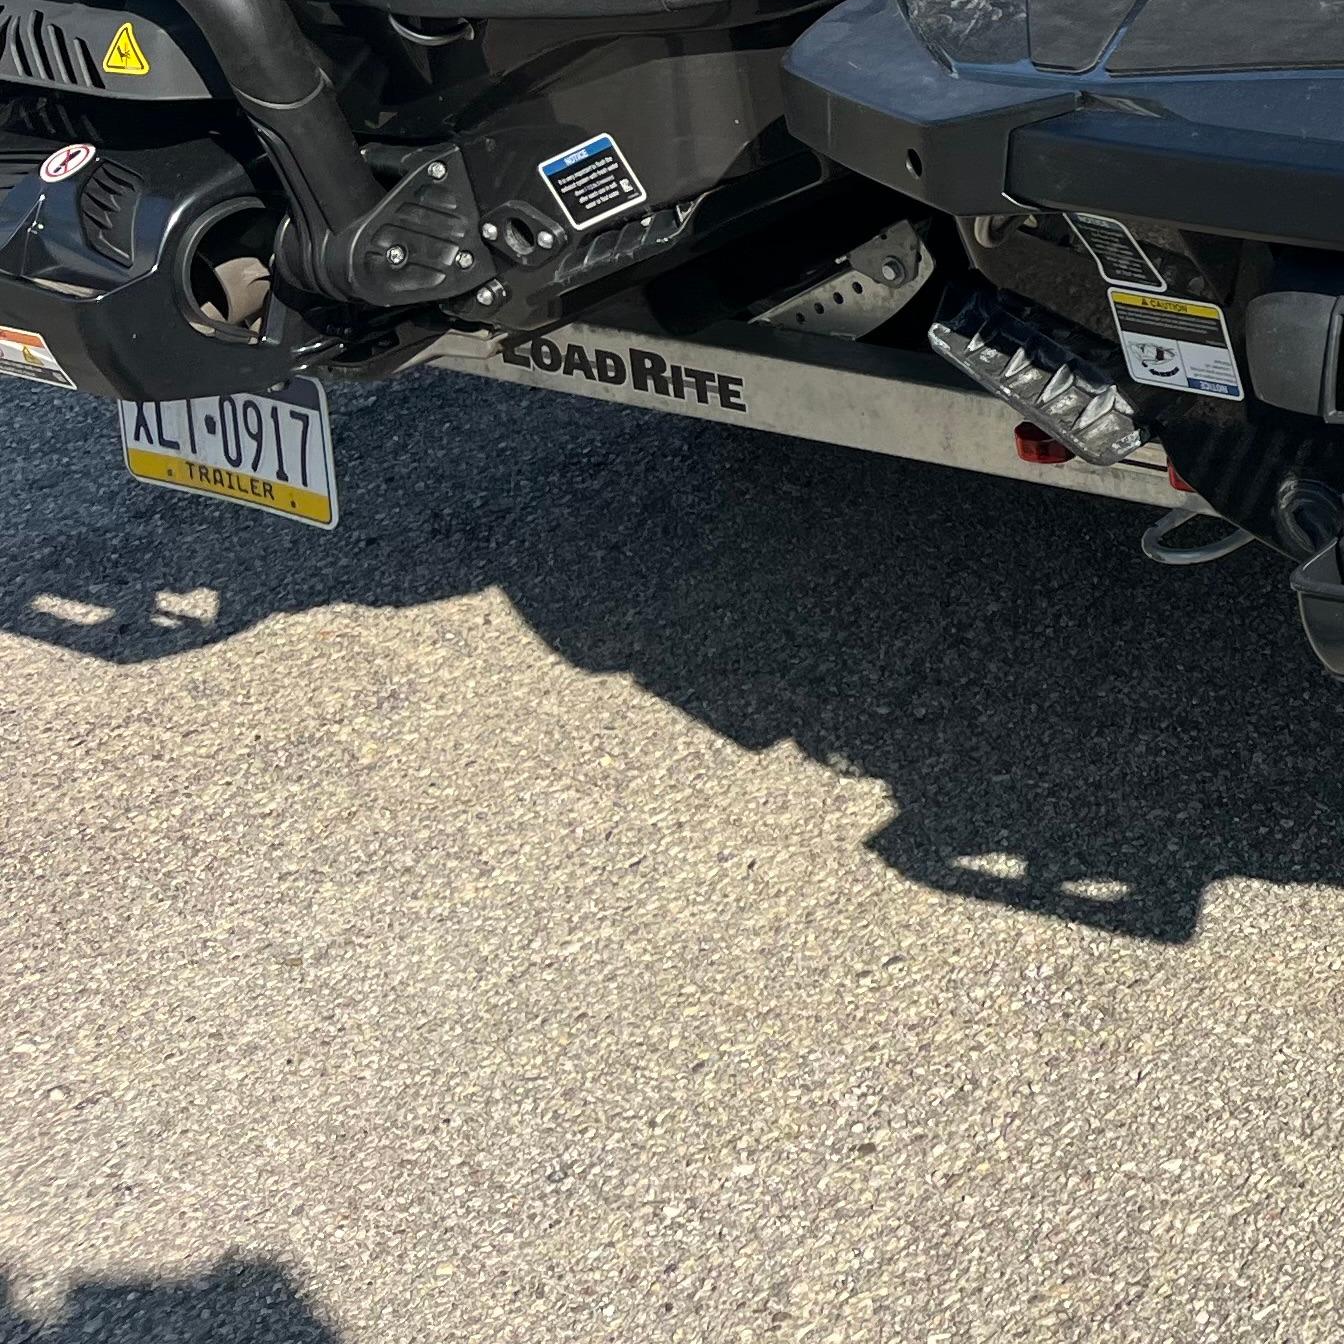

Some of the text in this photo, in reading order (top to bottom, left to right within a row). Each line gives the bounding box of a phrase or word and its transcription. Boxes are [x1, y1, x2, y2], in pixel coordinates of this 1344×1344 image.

[563, 149, 589, 166] NOTICE
[1150, 299, 1188, 313] CAUTION
[185, 460, 275, 501] TRAILER
